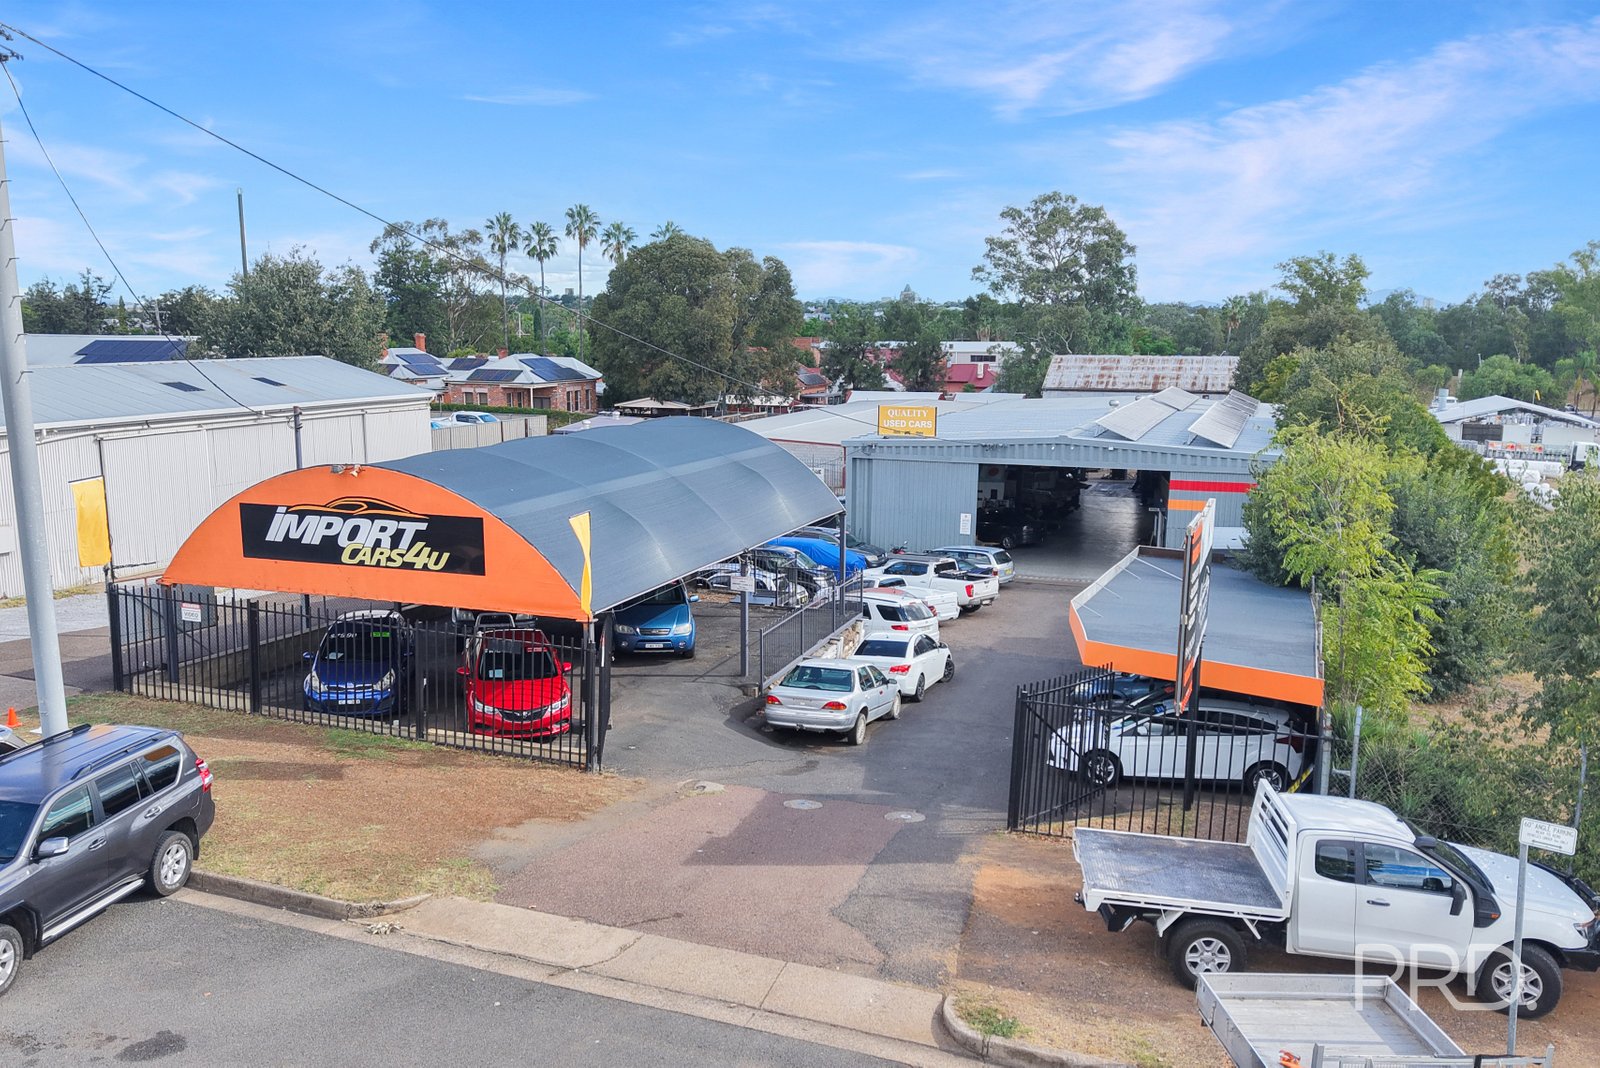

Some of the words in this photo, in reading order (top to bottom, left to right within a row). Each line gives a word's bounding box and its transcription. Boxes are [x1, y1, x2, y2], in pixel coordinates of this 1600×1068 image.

[887, 409, 928, 418] QUALITY
[883, 419, 907, 428] USED
[908, 420, 932, 429] CARS
[1535, 824, 1550, 832] ANGLE
[1553, 827, 1574, 837] PARKING
